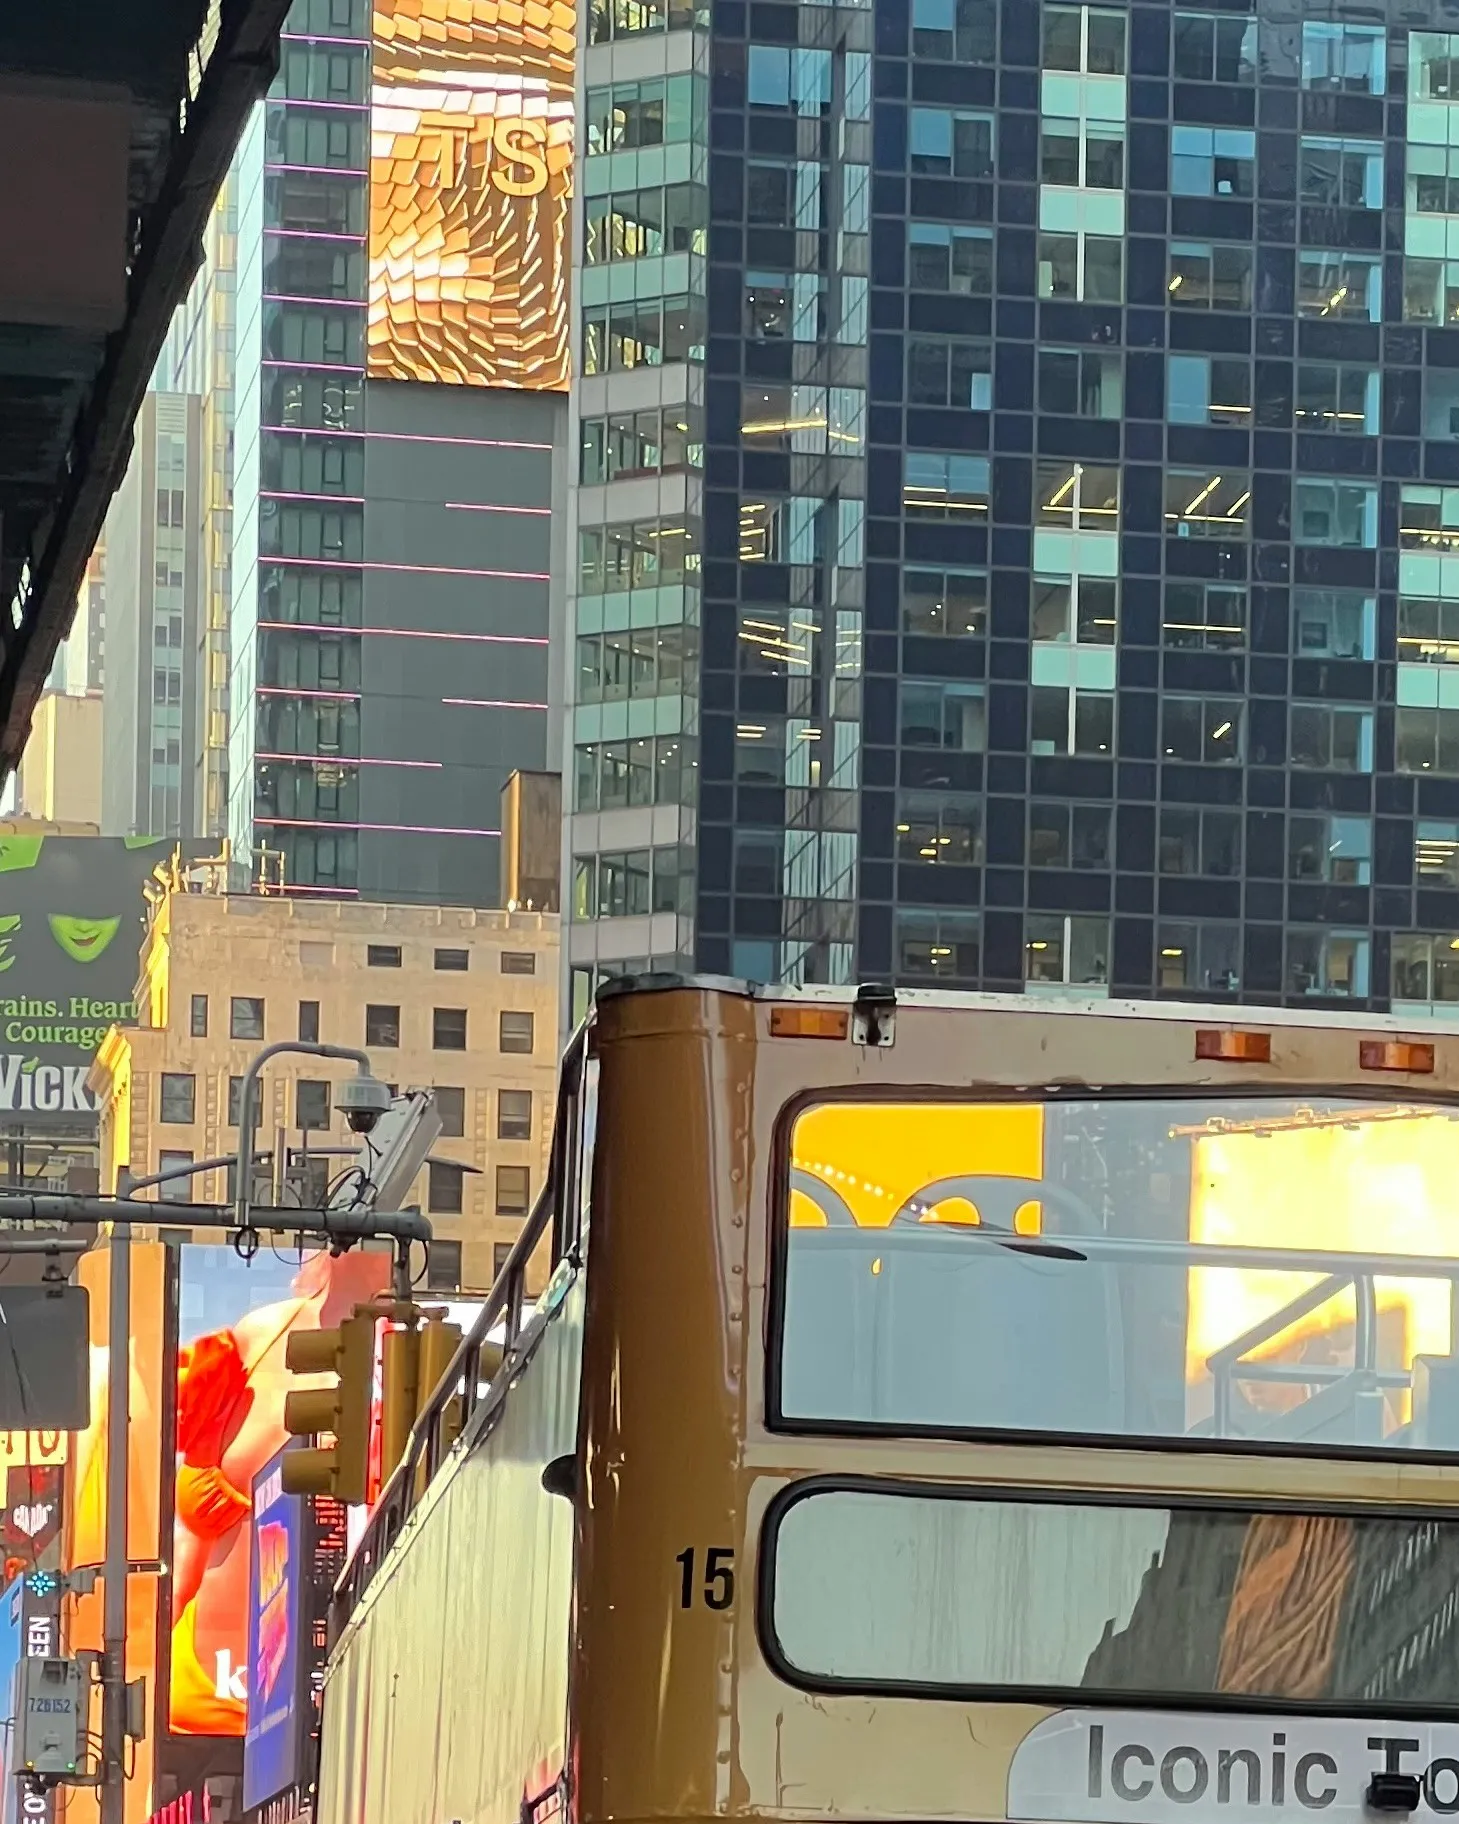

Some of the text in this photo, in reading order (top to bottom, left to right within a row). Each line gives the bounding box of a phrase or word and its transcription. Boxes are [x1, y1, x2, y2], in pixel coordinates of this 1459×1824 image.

[0, 995, 63, 1018] ains.
[675, 1546, 735, 1611] 15
[28, 1616, 50, 1657] EEN
[1086, 1724, 1338, 1811] Iconic
